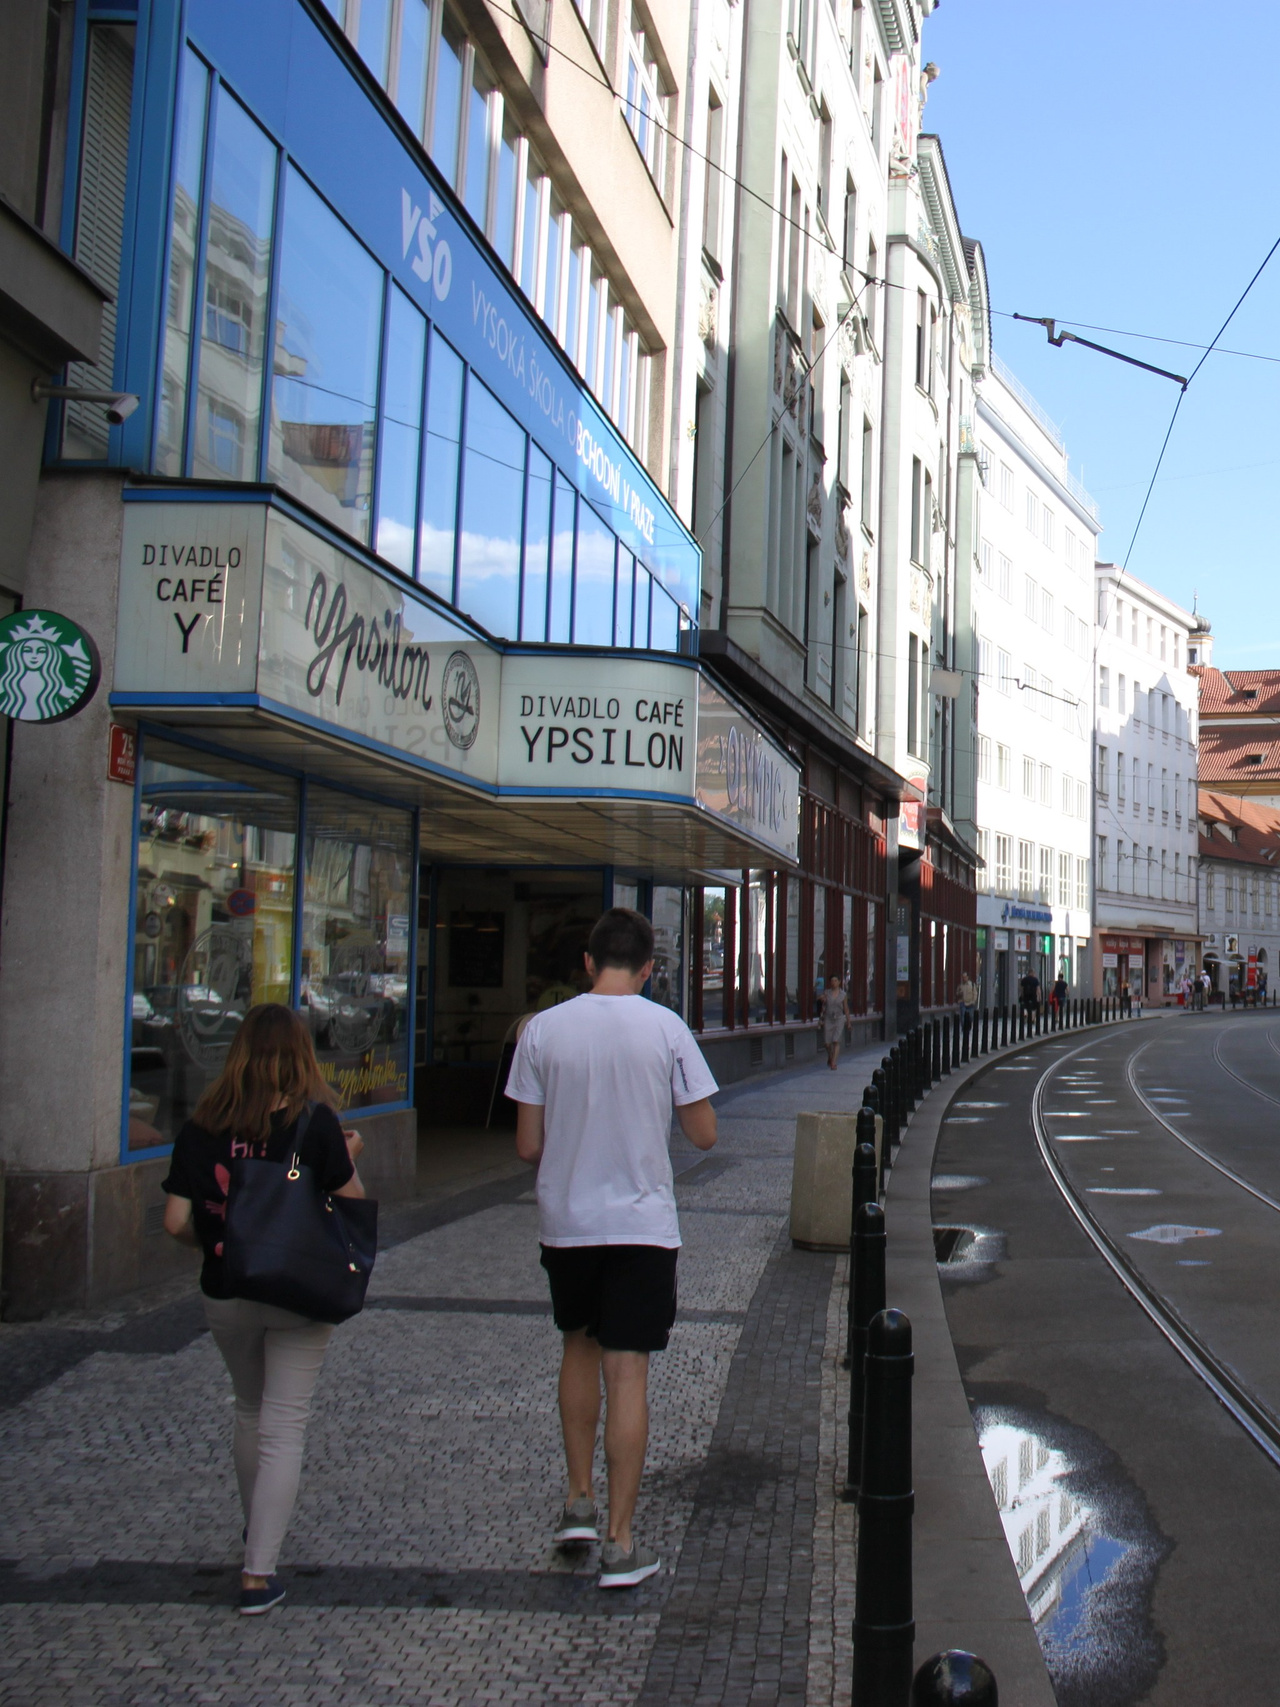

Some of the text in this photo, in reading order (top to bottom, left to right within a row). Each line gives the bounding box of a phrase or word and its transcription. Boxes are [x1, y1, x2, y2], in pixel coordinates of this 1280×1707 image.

[471, 280, 656, 546] VYSOKÁ ŠKOLA OBCHODNÍ V PRAZE
[142, 543, 242, 570] DIVADLO
[156, 572, 224, 603] CAFÉ
[174, 612, 202, 654] Y
[520, 694, 685, 726] DIVADLO CAFÉ
[520, 725, 685, 773] YPSILON
